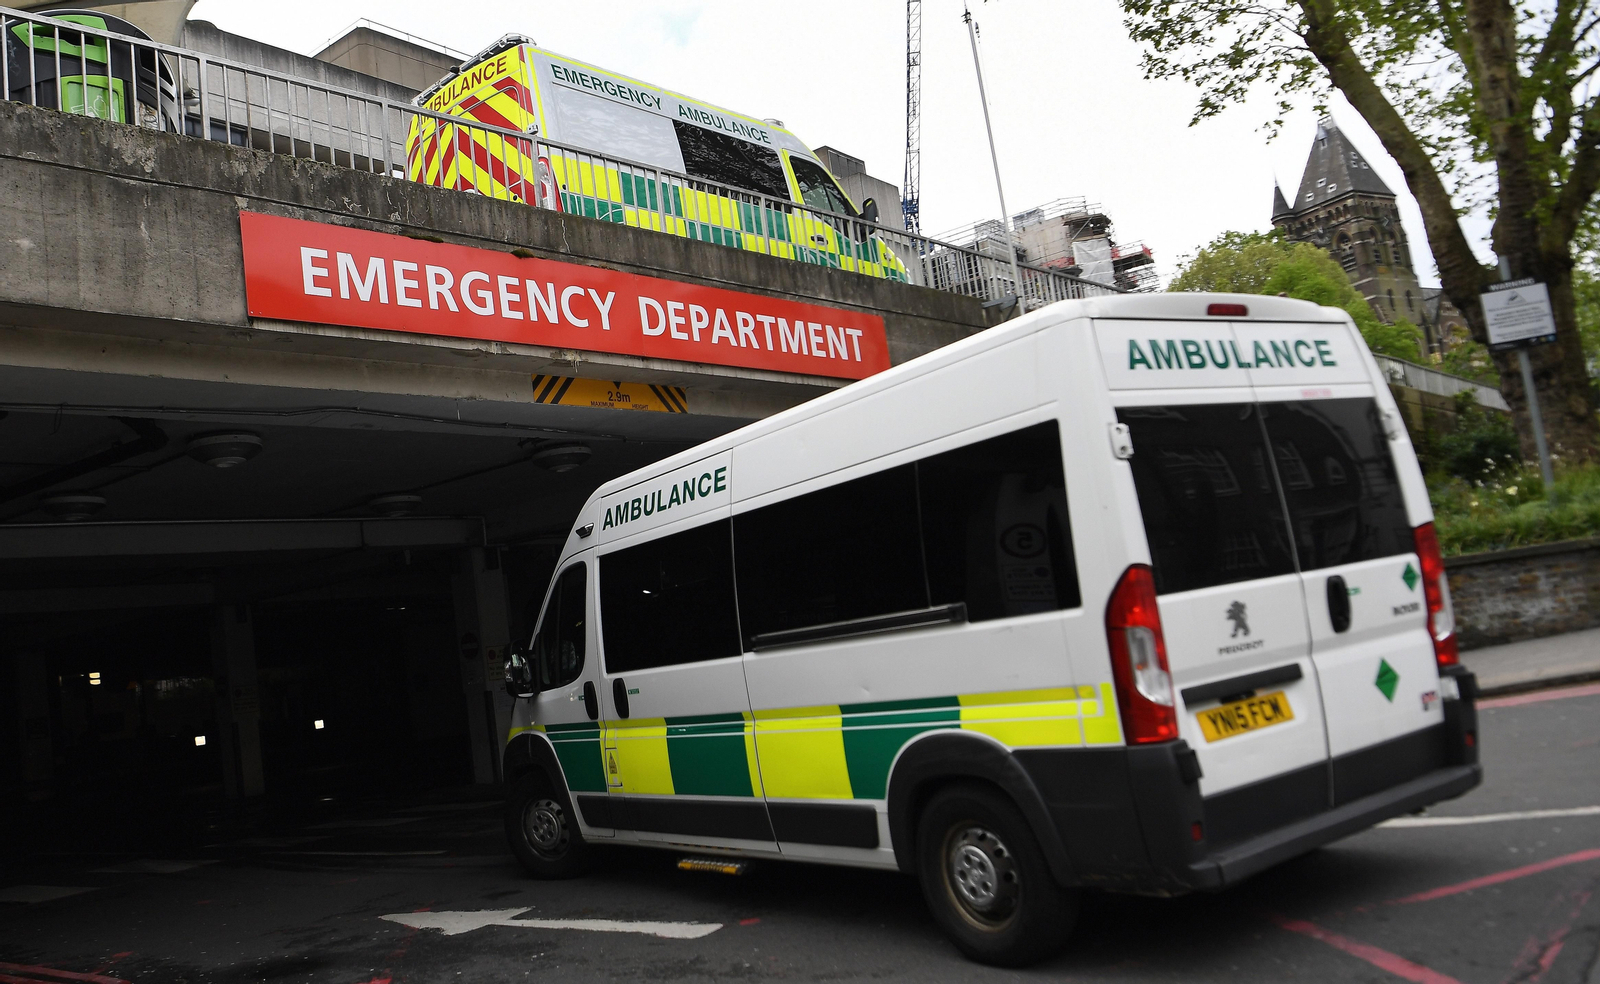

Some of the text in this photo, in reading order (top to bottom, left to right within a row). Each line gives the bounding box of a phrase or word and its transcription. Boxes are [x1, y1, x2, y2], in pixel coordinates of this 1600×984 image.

[551, 63, 771, 145] EMERGENCY AMBULANCE
[300, 247, 863, 363] EMERGENCY DEPARTMENT
[1489, 278, 1535, 290] WARNING
[1128, 339, 1336, 370] AMBULANCE
[607, 391, 631, 403] 2.9m
[603, 466, 727, 530] AMBULANCE
